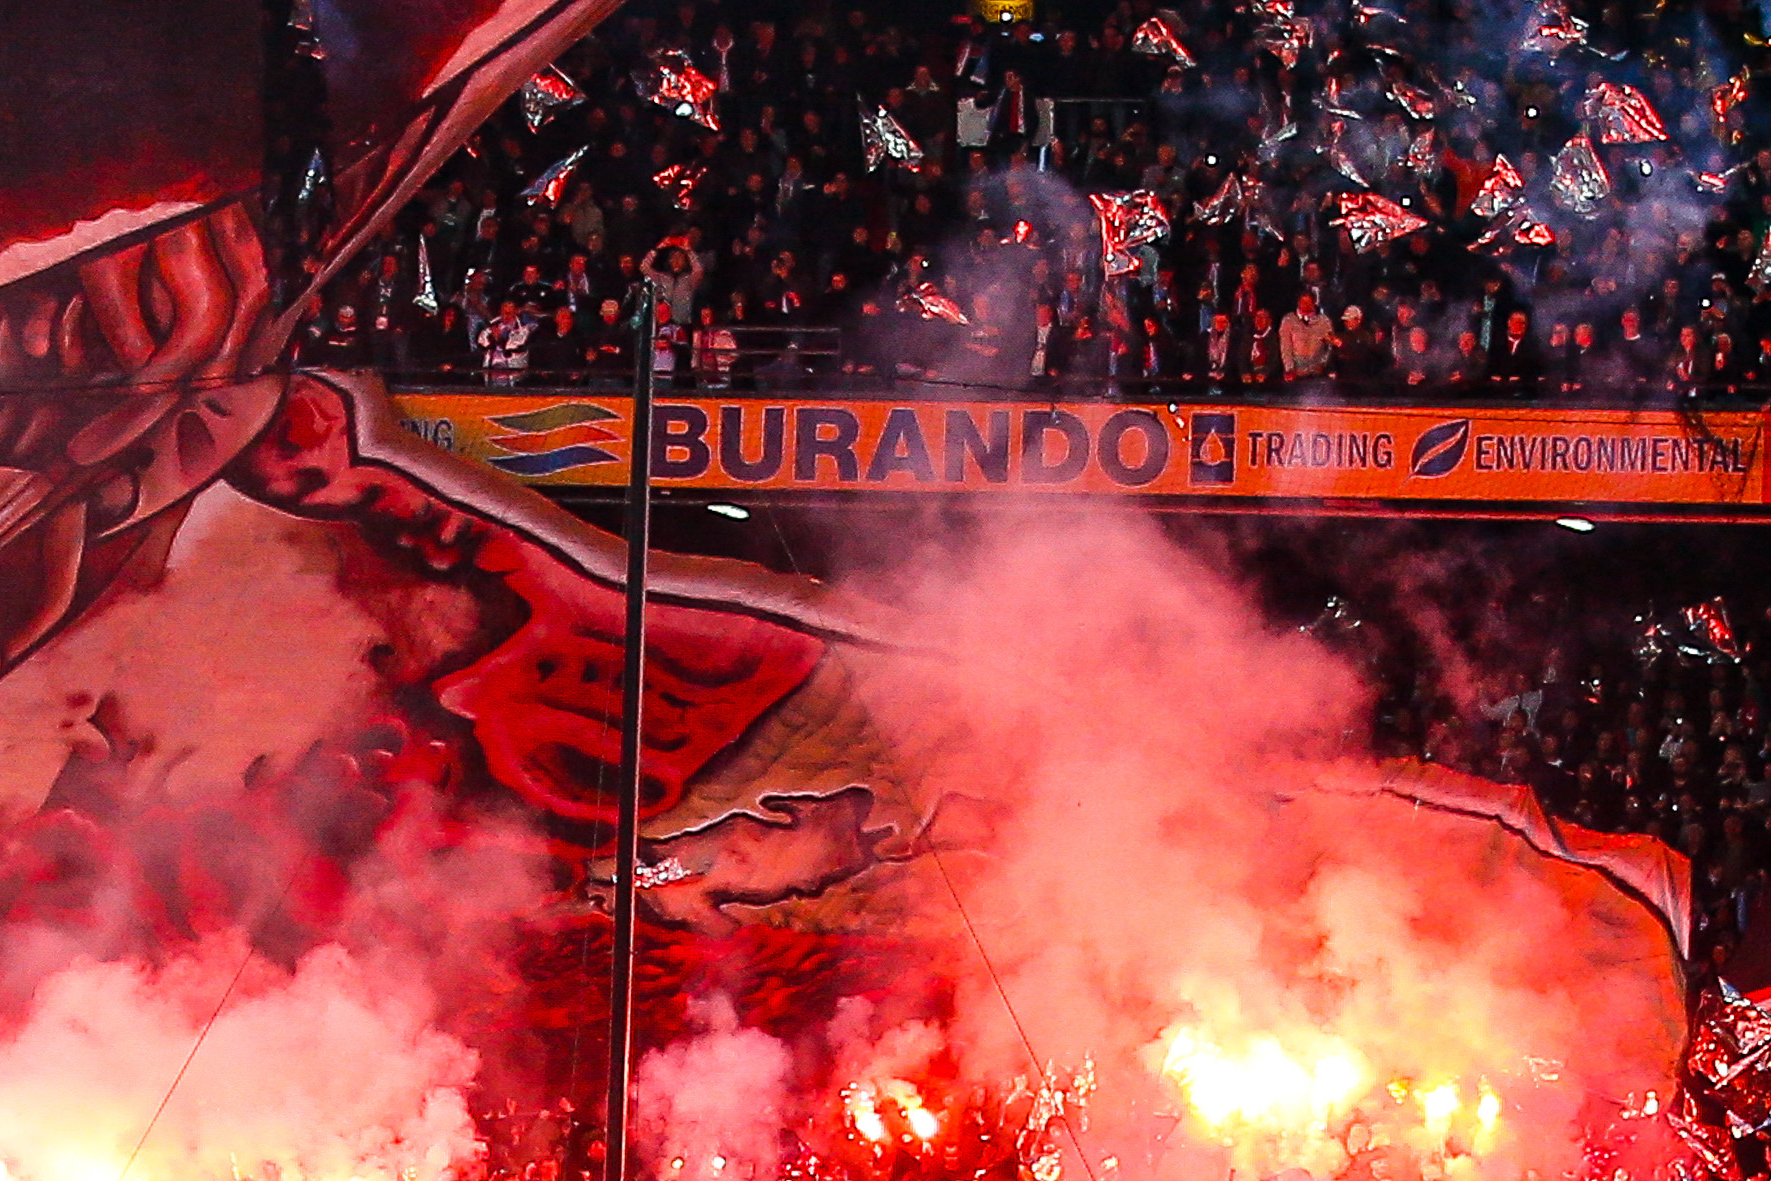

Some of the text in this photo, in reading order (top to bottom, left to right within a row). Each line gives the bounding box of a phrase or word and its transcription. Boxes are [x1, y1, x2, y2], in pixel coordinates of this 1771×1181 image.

[651, 403, 1170, 488] BURANDO
[1247, 431, 1394, 468] TRADING
[1474, 435, 1747, 474] ENVIRONMENTAL
